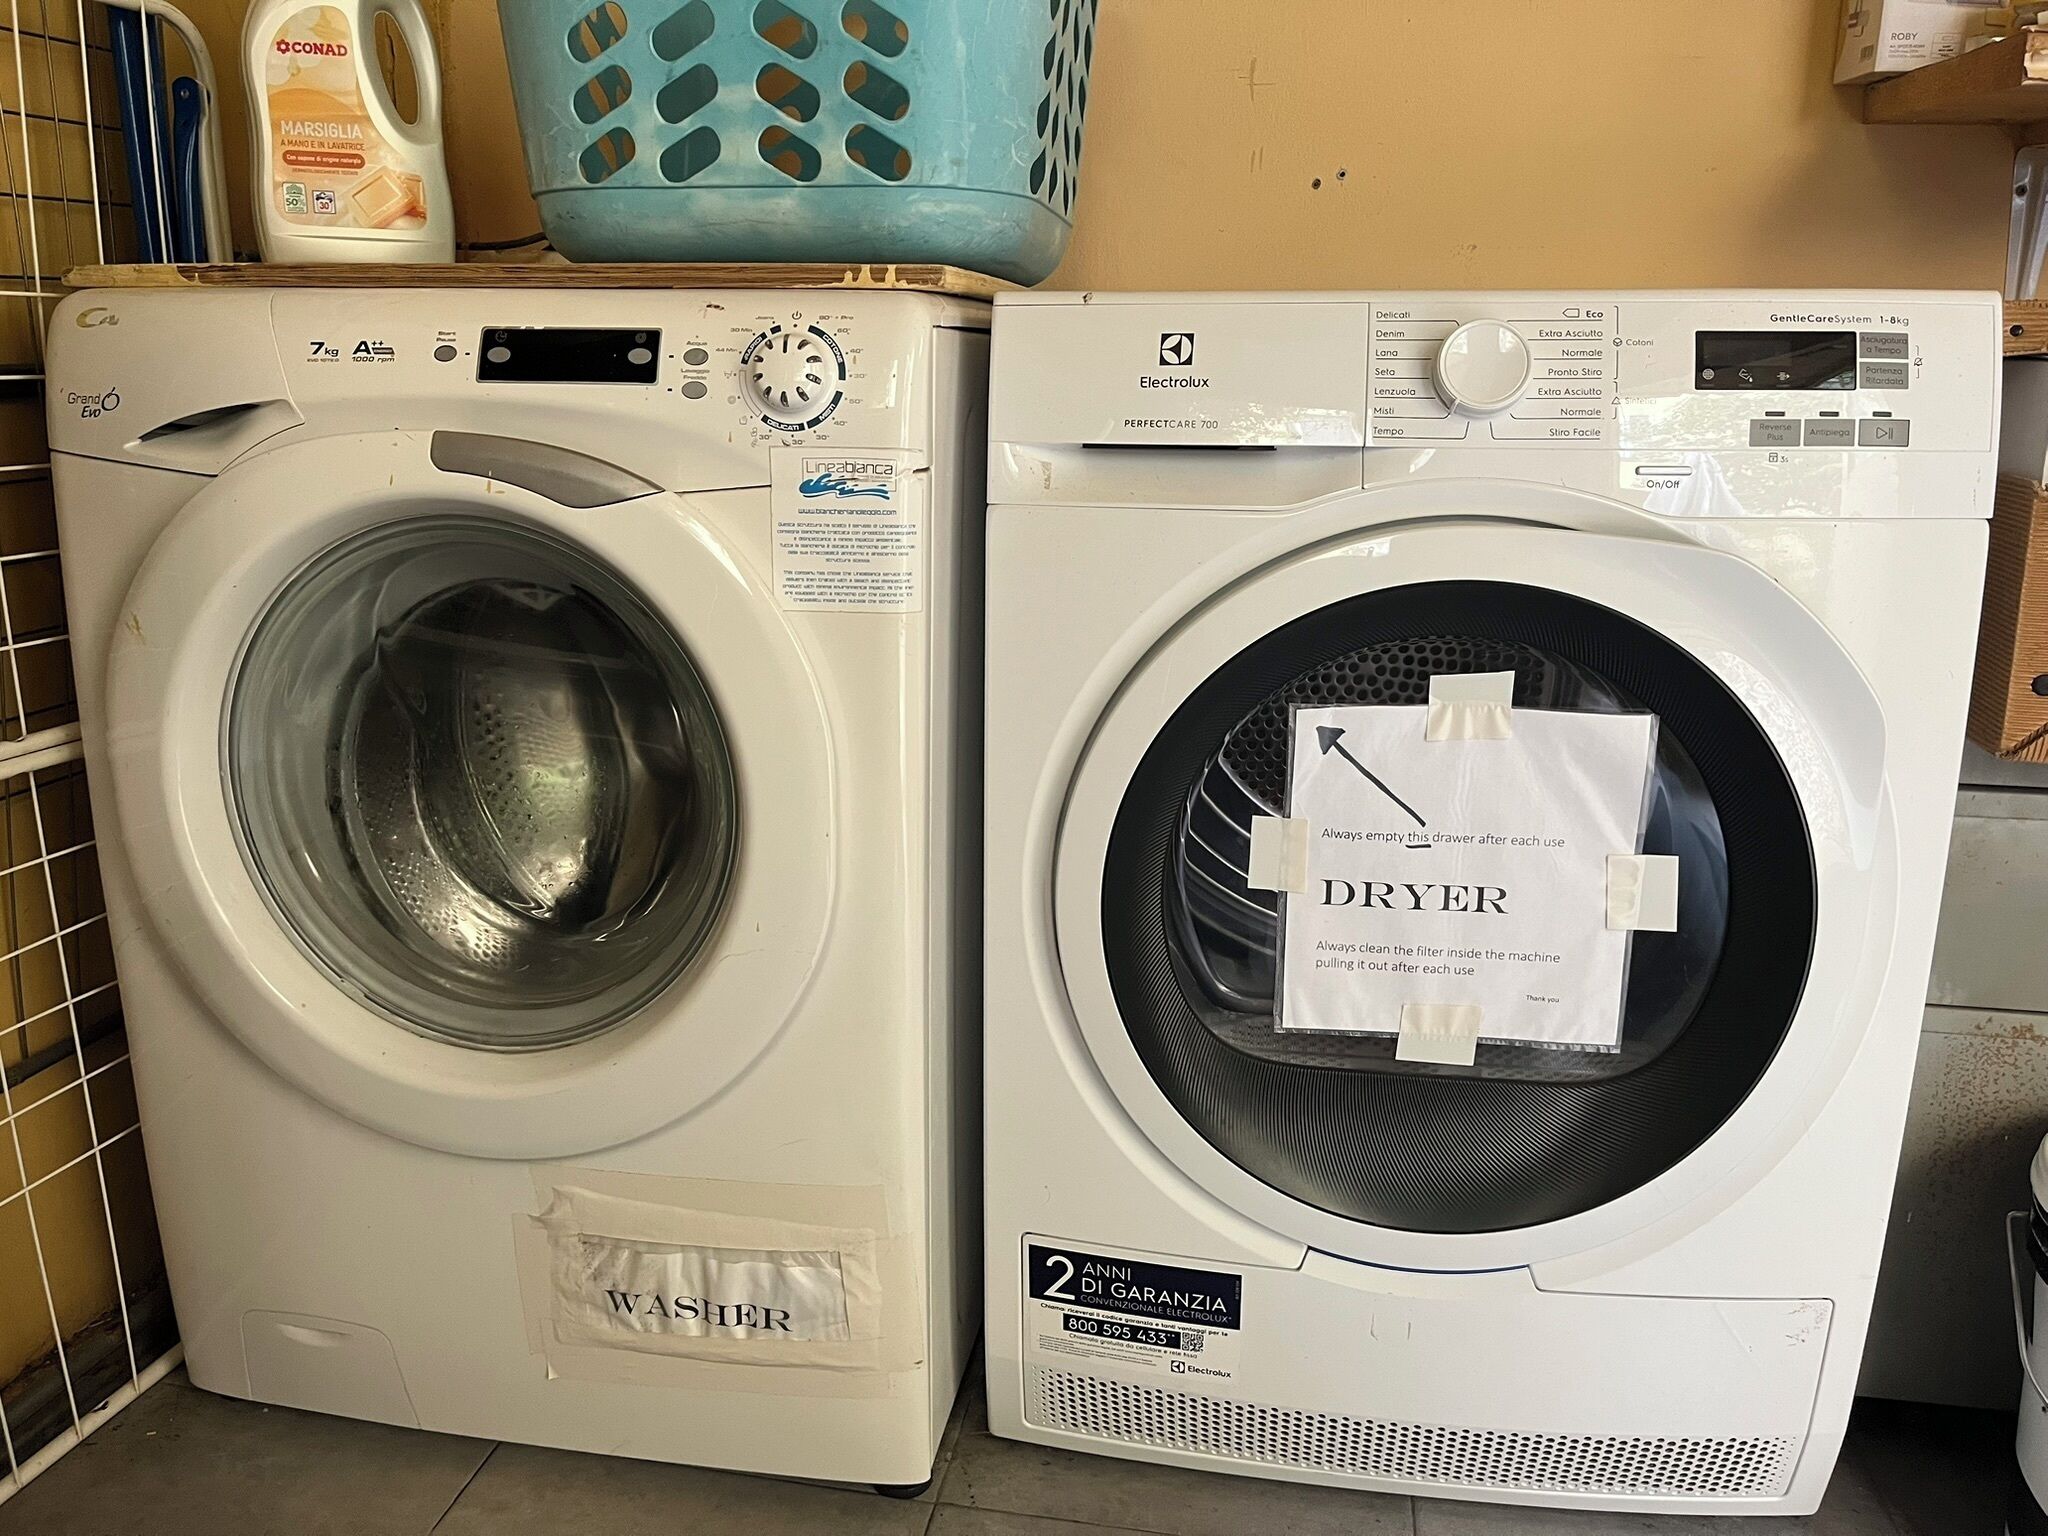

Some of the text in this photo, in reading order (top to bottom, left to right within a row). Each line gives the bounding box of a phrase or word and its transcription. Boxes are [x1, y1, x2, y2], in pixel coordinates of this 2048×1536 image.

[1890, 32, 1920, 42] ROBY
[291, 41, 348, 56] CONAD
[281, 121, 362, 139] MARSIGLIA
[287, 140, 309, 149] MANO
[318, 141, 326, 150] IN
[328, 142, 366, 152] LAVATRICE
[319, 201, 330, 210] 30
[1376, 311, 1411, 320] Delicati
[1586, 310, 1604, 318] Eco
[1769, 313, 1910, 327] GentleCareSystem 1-8kg
[1375, 330, 1405, 338] Denim
[1539, 330, 1604, 338] Extra Asciutto
[1625, 338, 1654, 346] Cotoni
[1860, 335, 1908, 347] Asciugatura
[1375, 349, 1398, 357] Lana
[1562, 349, 1604, 357] Normale
[1873, 345, 1903, 355] Tempo
[1374, 368, 1396, 376] Seta
[1548, 368, 1603, 376] Pronto Stiro
[1865, 366, 1903, 375] Partenza
[1140, 375, 1210, 389] Electrolux
[1865, 376, 1904, 386] Ritardata
[1374, 387, 1416, 396] Lenzuola
[1538, 388, 1602, 396] Extra Asciutto
[81, 405, 101, 418] Evo
[1373, 407, 1395, 415] Misti
[1560, 408, 1602, 417] Normale
[1124, 419, 1219, 430] PERFECTCARE 700
[1759, 423, 1793, 432] Reverse
[1373, 427, 1405, 437] Tempo
[1549, 428, 1601, 437] Stiro Facile
[1810, 428, 1851, 438] Antipiega
[1767, 434, 1784, 442] Plus
[805, 460, 893, 476] Lineabianca
[1646, 479, 1681, 490] On/Off
[1321, 828, 1566, 848] Always empty this drawer after each use
[1319, 878, 1510, 915] DRYER
[1316, 941, 1561, 963] Always clean the filter inside the machine
[1316, 957, 1475, 976] pulling it out after each use
[1526, 994, 1546, 1002] Thank
[1043, 1255, 1131, 1301] 2 ANNI
[1081, 1277, 1103, 1295] DI
[1110, 1282, 1228, 1313] GARANZIA
[1080, 1294, 1165, 1316] CONVENZIONALE
[604, 1289, 794, 1333] WASHER
[1069, 1318, 1098, 1334] 800
[1102, 1323, 1132, 1340] 595
[1101, 1314, 1123, 1322] codice
[1124, 1318, 1154, 1327] garanzia
[1177, 1325, 1207, 1335] vantaggi
[1068, 1332, 1100, 1344] Chiamata
[1135, 1345, 1162, 1353] cellulare
[1187, 1365, 1232, 1379] Electrolux
